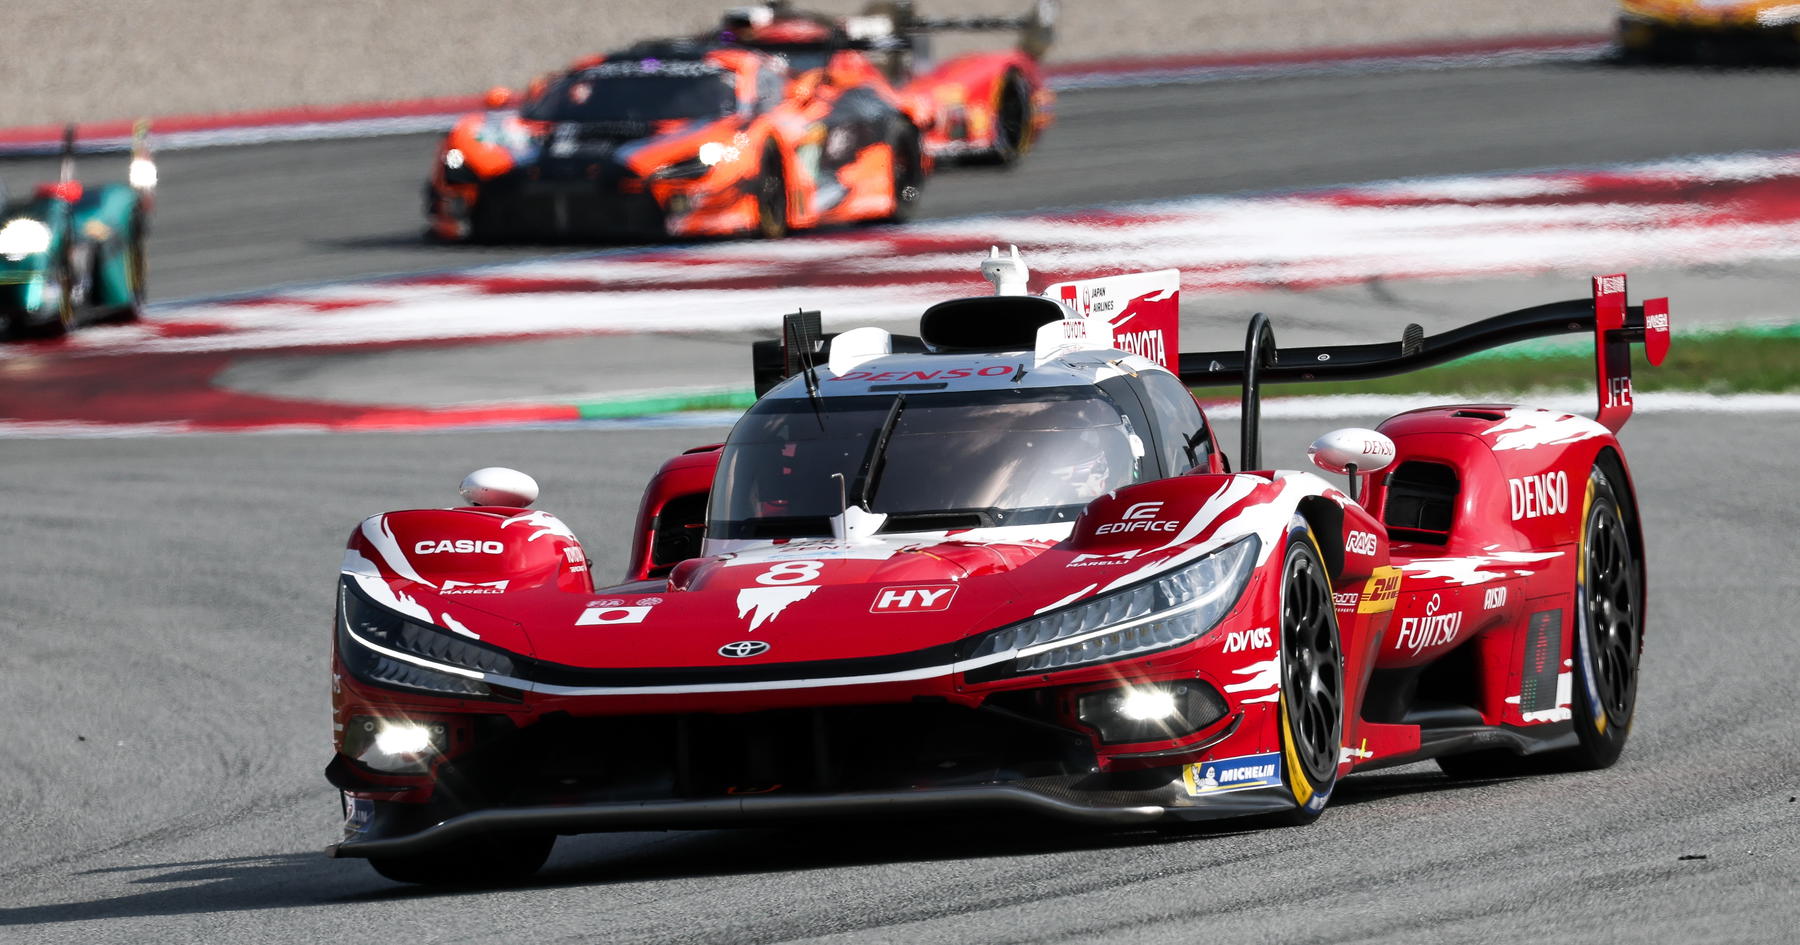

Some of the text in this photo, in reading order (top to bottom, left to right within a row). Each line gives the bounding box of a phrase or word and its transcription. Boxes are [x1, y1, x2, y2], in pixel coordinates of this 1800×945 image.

[1091, 287, 1106, 299] JAPAN
[1093, 300, 1114, 312] AIRLINES
[1062, 321, 1087, 339] TOYOTA
[1117, 329, 1167, 367] TOYOTA
[827, 365, 1013, 382] DENSO
[1604, 376, 1633, 408] JFE
[1362, 440, 1394, 456] DENSO
[1509, 470, 1568, 521] DENSO
[1095, 520, 1180, 536] EDIFICE
[414, 539, 504, 555] CASIO
[1345, 530, 1377, 556] RAYS
[755, 560, 825, 586] 8
[1065, 559, 1130, 568] MARELLI
[439, 588, 505, 596] MARELLI
[877, 588, 951, 608] HY
[1368, 575, 1399, 602] DHL
[1484, 586, 1507, 610] AISIN
[1395, 610, 1462, 657] FUJITSU
[1219, 763, 1275, 783] MICHELIN
